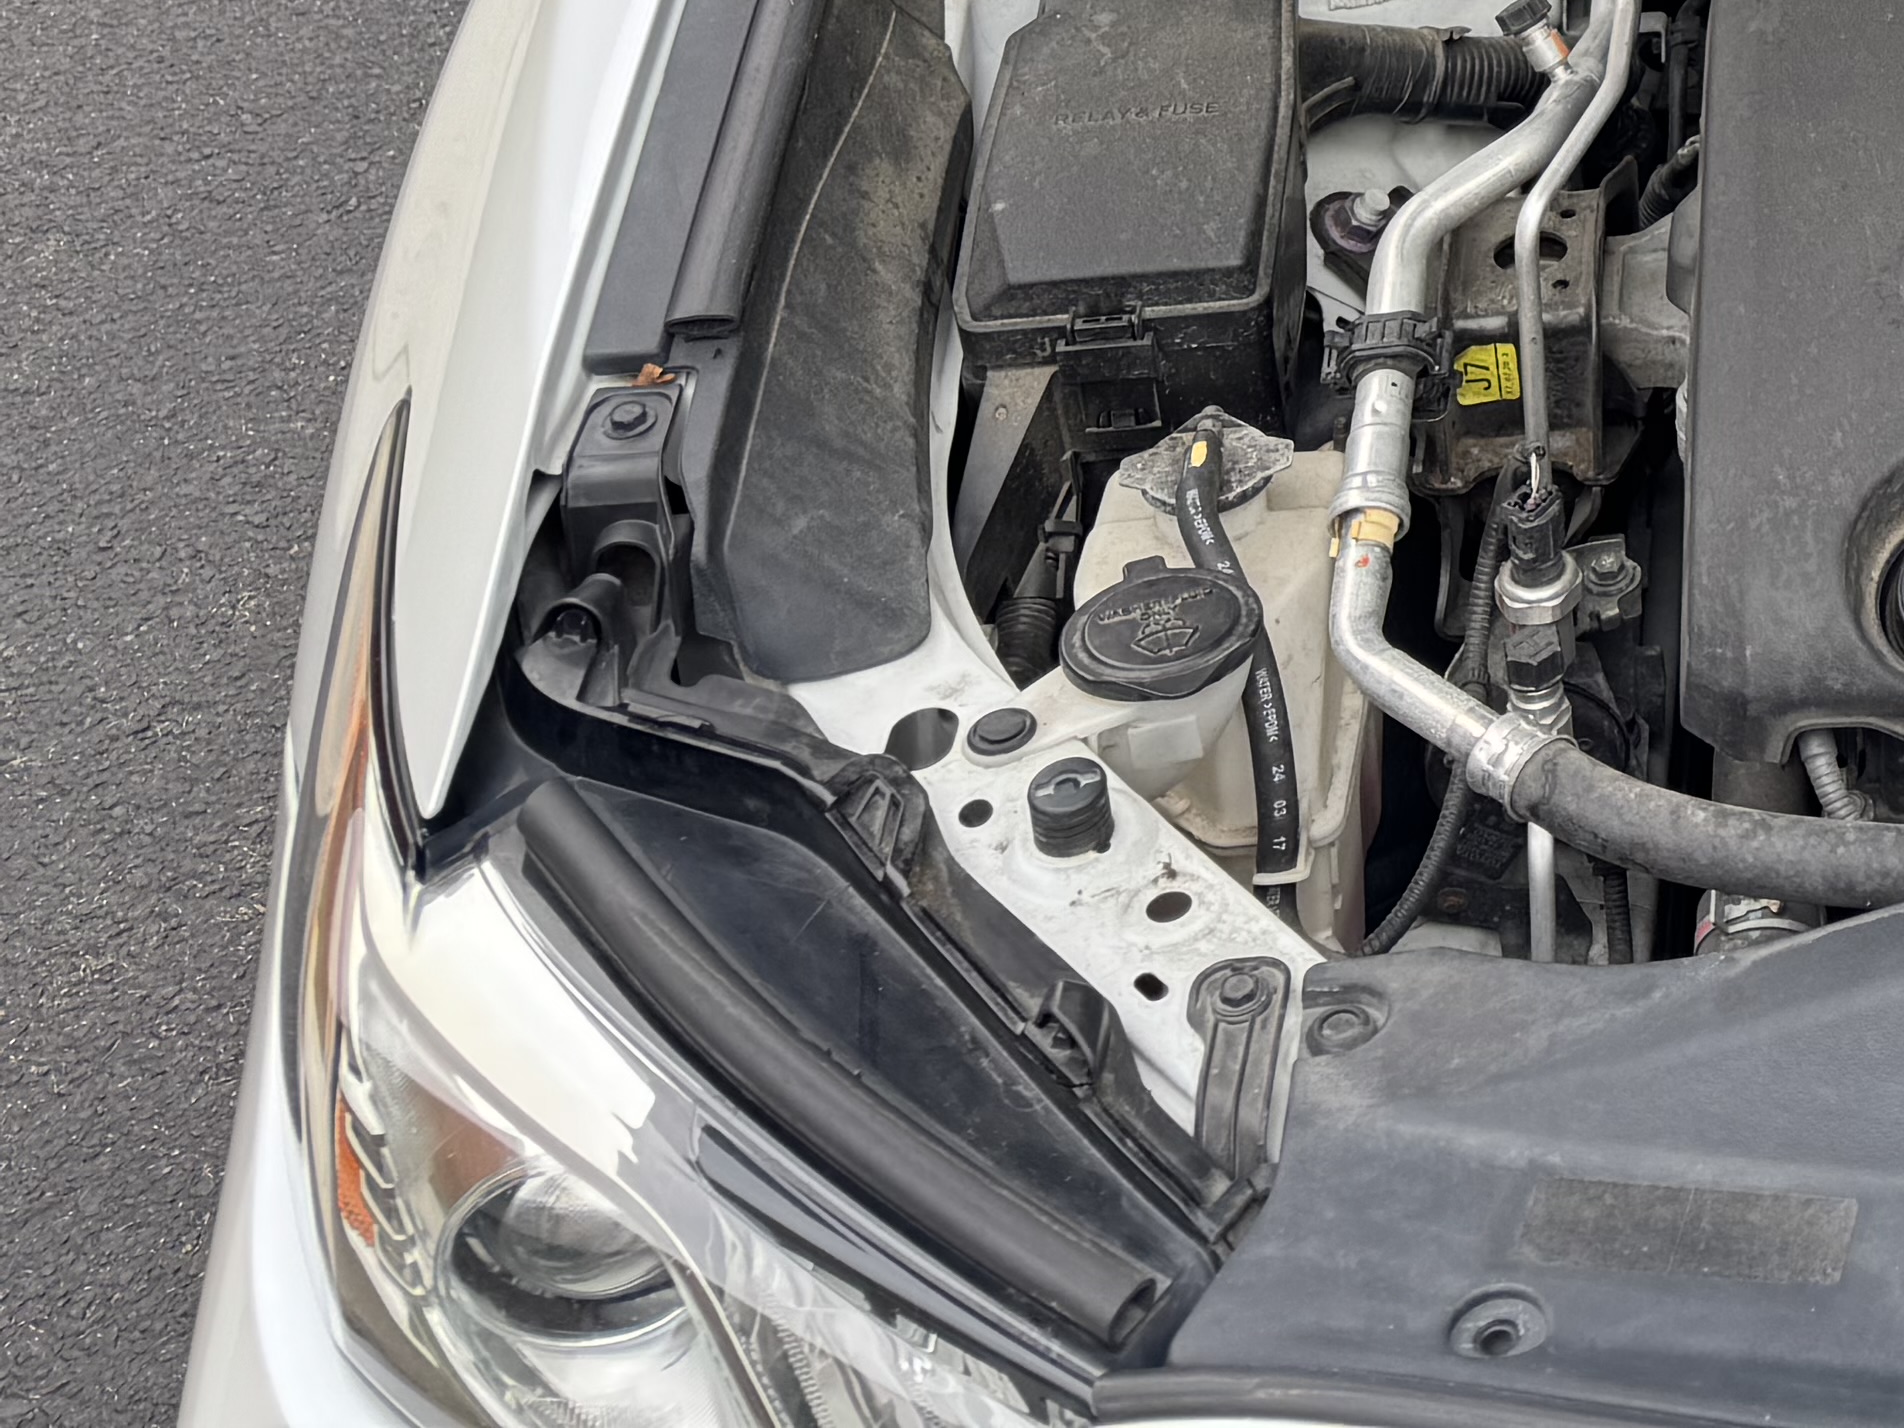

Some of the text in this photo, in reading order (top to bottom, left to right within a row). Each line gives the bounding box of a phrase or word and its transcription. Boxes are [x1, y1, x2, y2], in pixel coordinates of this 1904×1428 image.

[1054, 106, 1131, 125] RELAY
[1157, 101, 1219, 119] FUSE
[1463, 362, 1492, 391] J7
[1256, 668, 1272, 702] WATER
[1271, 764, 1286, 784] 24
[1273, 800, 1287, 818] 03
[1273, 835, 1287, 850] 17
